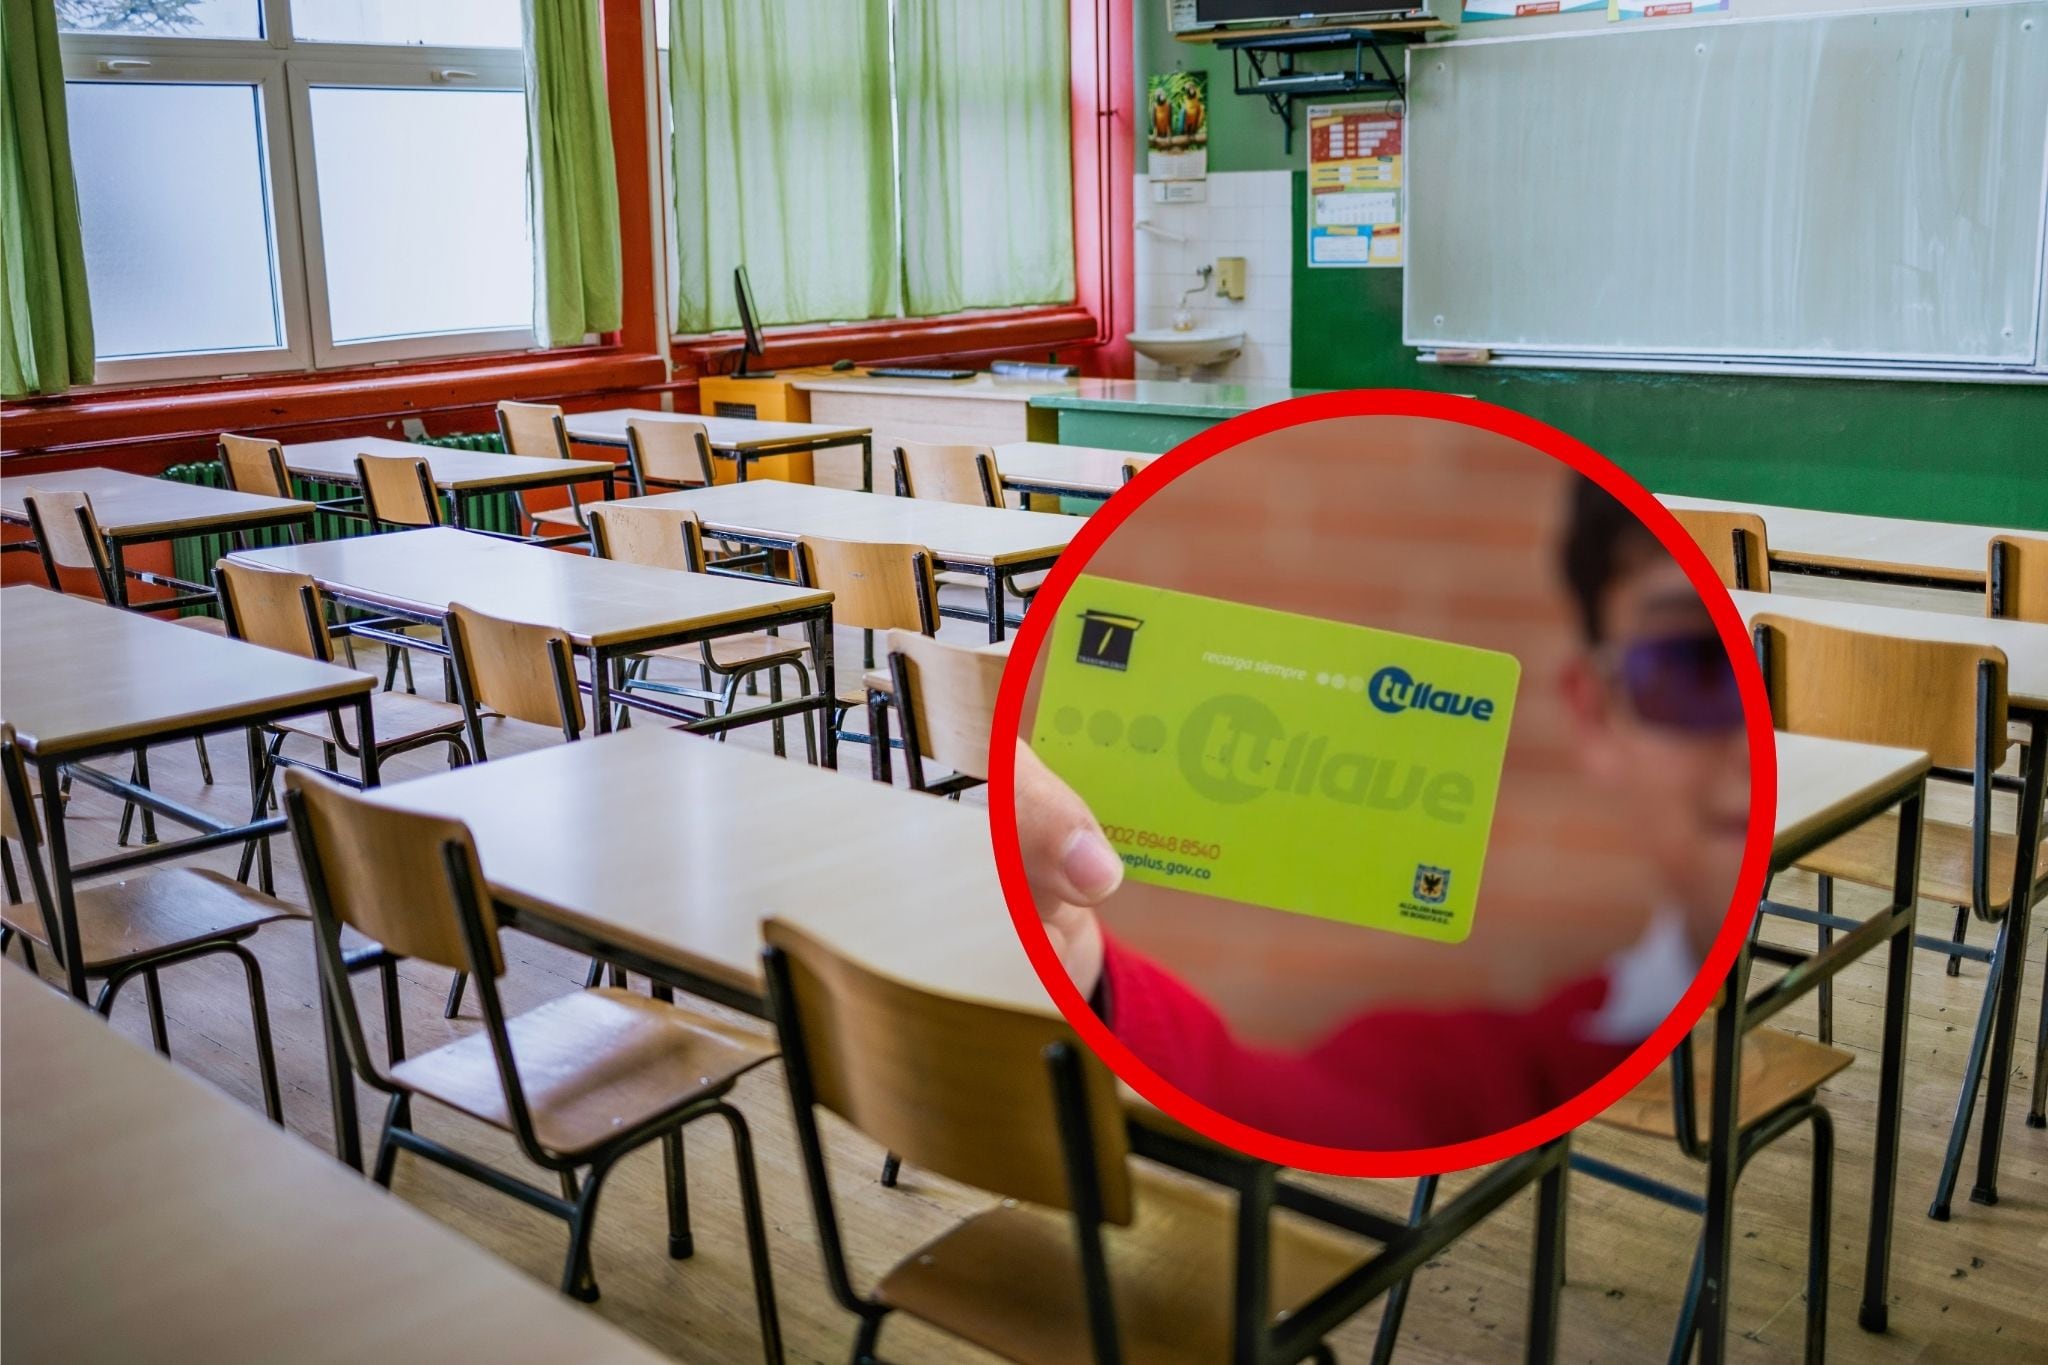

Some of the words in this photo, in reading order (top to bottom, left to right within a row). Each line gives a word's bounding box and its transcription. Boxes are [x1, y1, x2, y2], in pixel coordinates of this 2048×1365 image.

[1201, 651, 1253, 671] recarga
[1254, 660, 1307, 680] siempre
[1368, 666, 1494, 722] tullave
[1177, 694, 1475, 825] tullave
[1100, 823, 1135, 845] 002
[1136, 831, 1177, 852] 6948
[1180, 838, 1221, 860] 8540
[1118, 851, 1211, 879] veplus.gov.co
